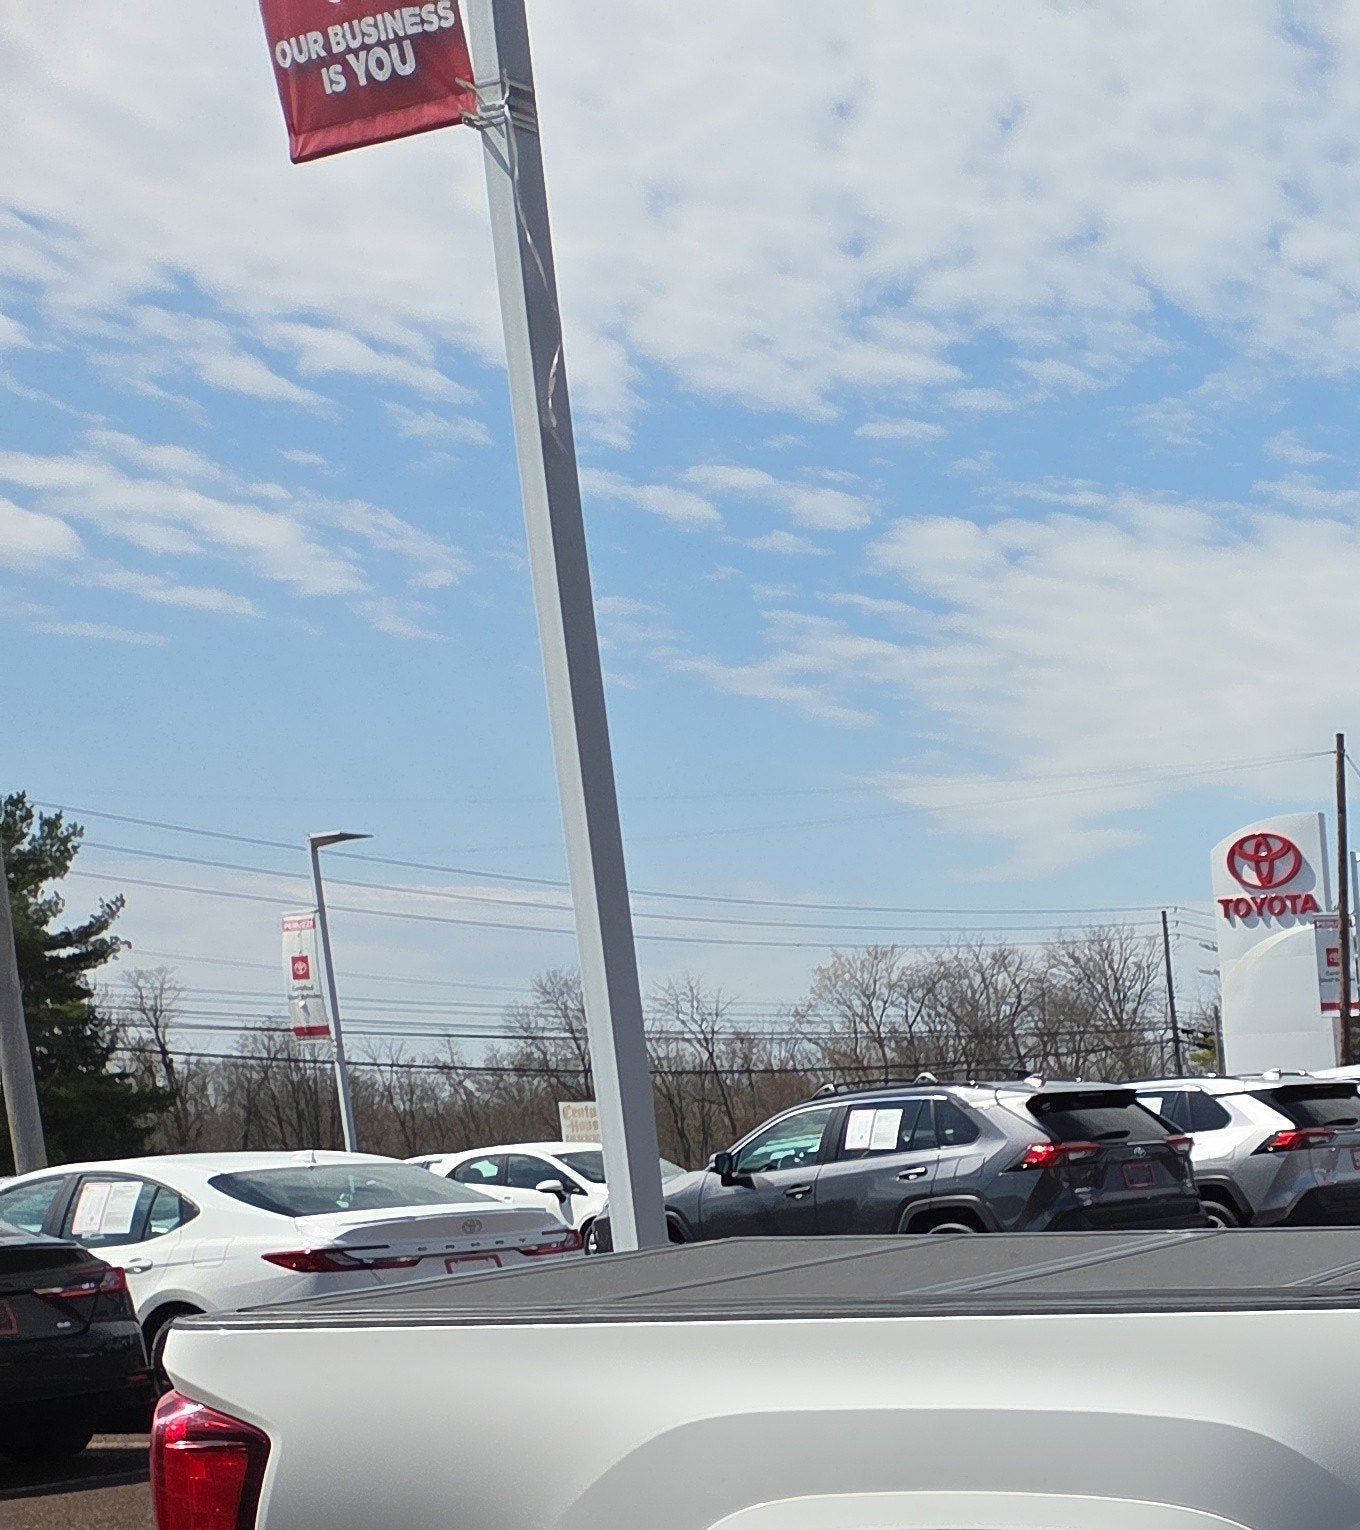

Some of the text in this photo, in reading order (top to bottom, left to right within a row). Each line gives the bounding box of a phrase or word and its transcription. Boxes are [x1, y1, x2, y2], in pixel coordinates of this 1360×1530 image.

[274, 1, 456, 69] OUR BUSINESS
[320, 40, 417, 95] IS YOU
[1218, 893, 1320, 920] TOYOTA
